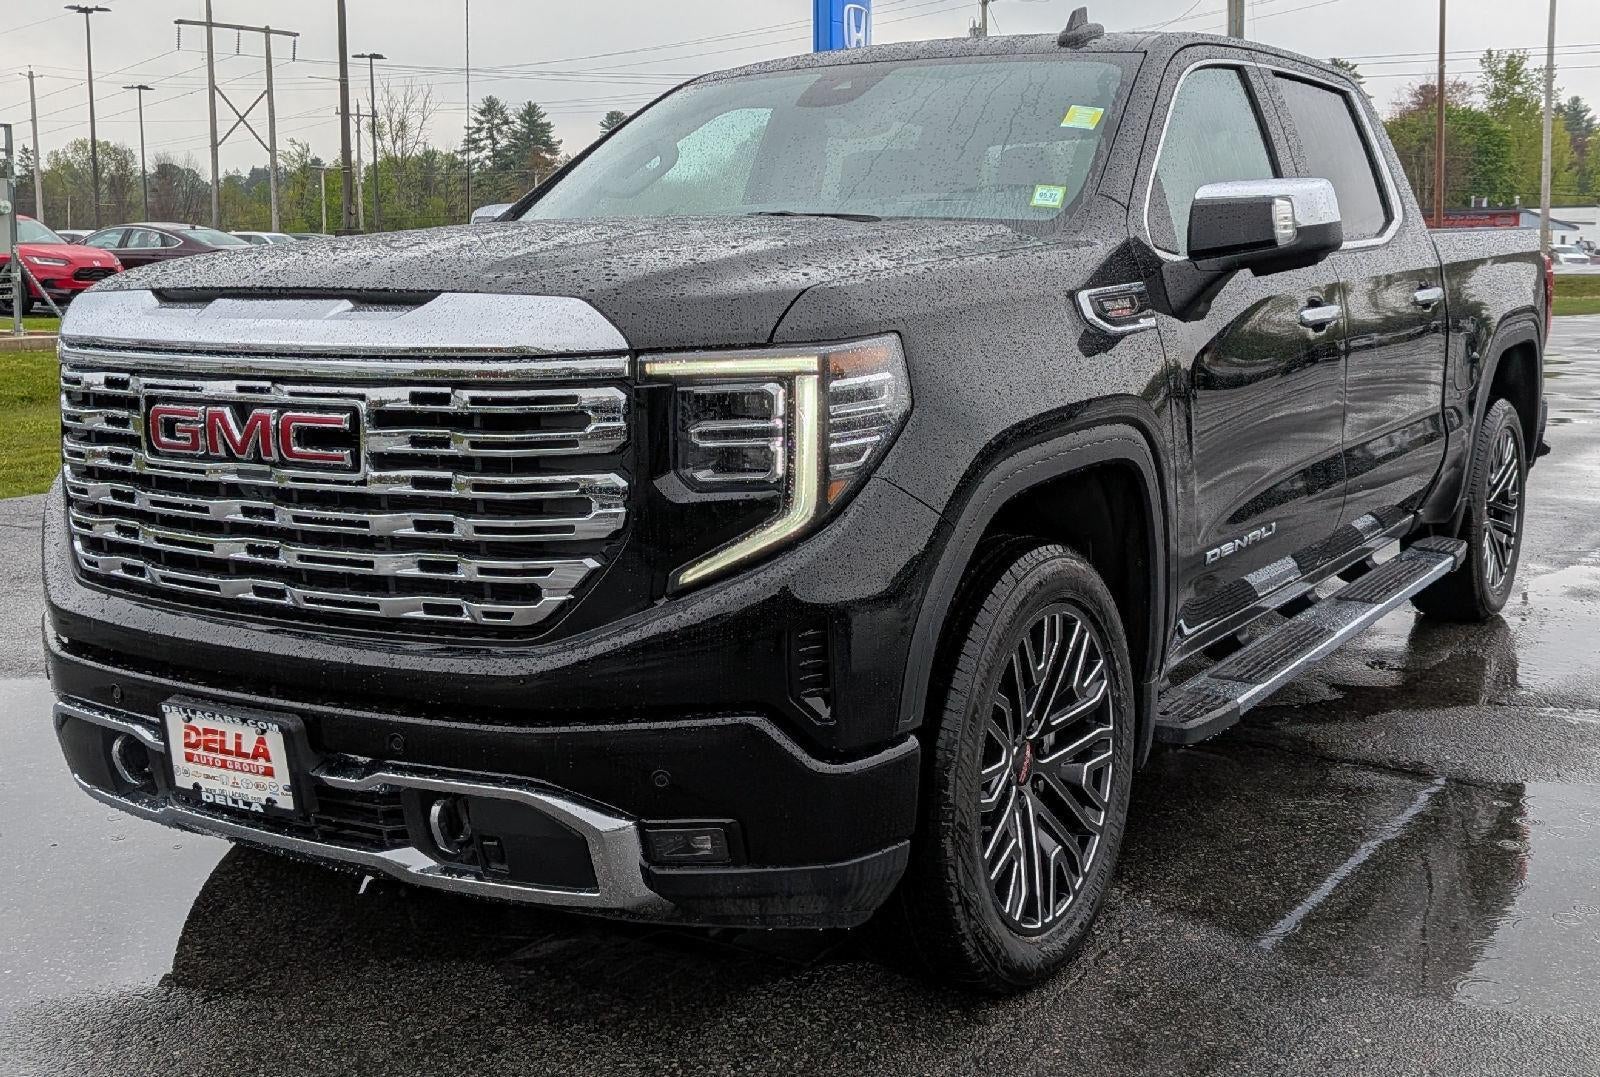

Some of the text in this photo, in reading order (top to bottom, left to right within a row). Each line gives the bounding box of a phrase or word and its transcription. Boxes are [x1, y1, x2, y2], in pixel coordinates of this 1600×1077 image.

[150, 404, 350, 465] GMC
[1205, 521, 1277, 566] DENALI
[161, 704, 280, 732] DELLACARS.COM
[183, 723, 273, 763] DELLA
[193, 753, 266, 775] AUTO GROUP
[201, 792, 264, 813] DELLA
